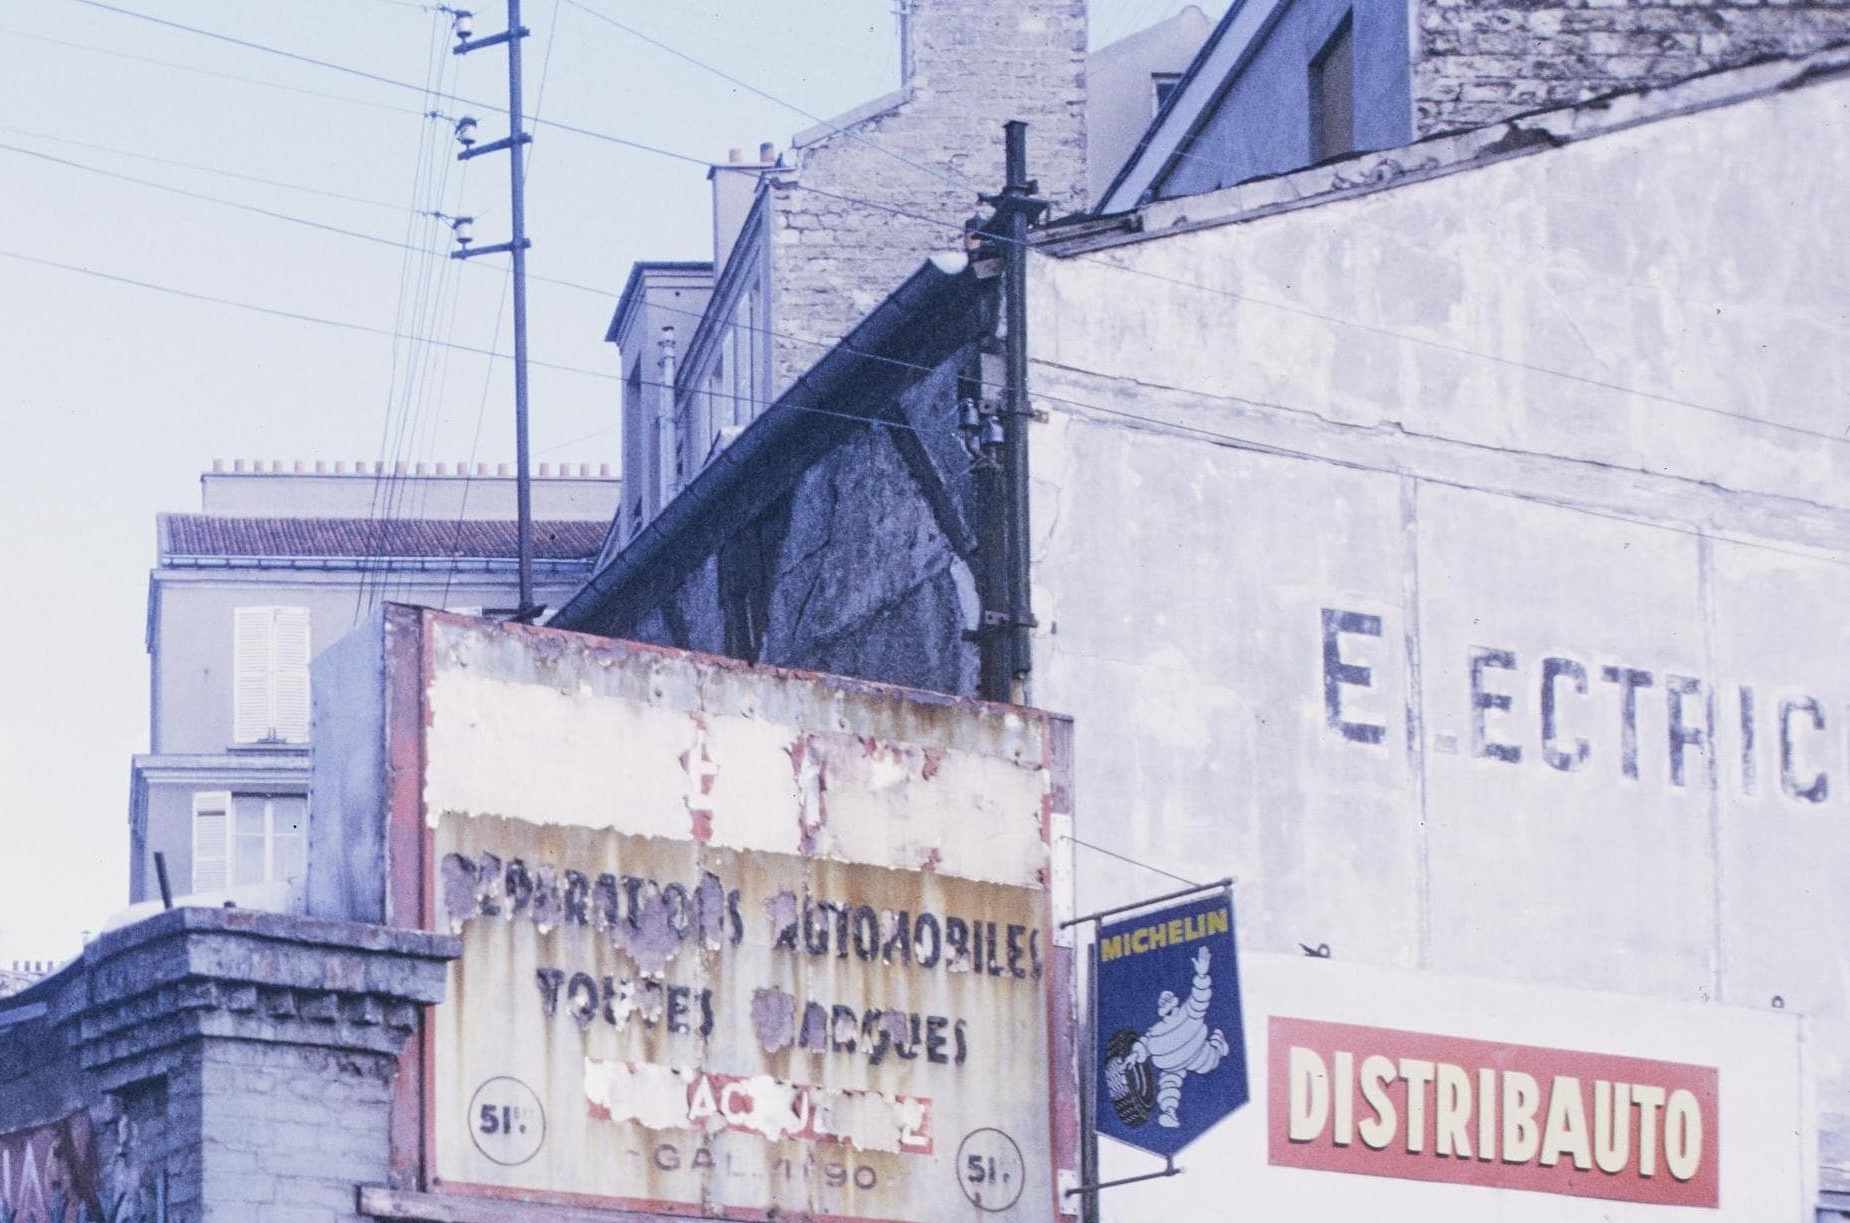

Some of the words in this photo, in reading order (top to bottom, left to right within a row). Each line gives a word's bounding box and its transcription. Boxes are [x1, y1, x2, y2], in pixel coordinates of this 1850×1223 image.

[1100, 908, 1228, 962] MICHELIN
[537, 967, 714, 1042] TOUES
[1288, 1046, 1704, 1180] DISTRIBAUTO
